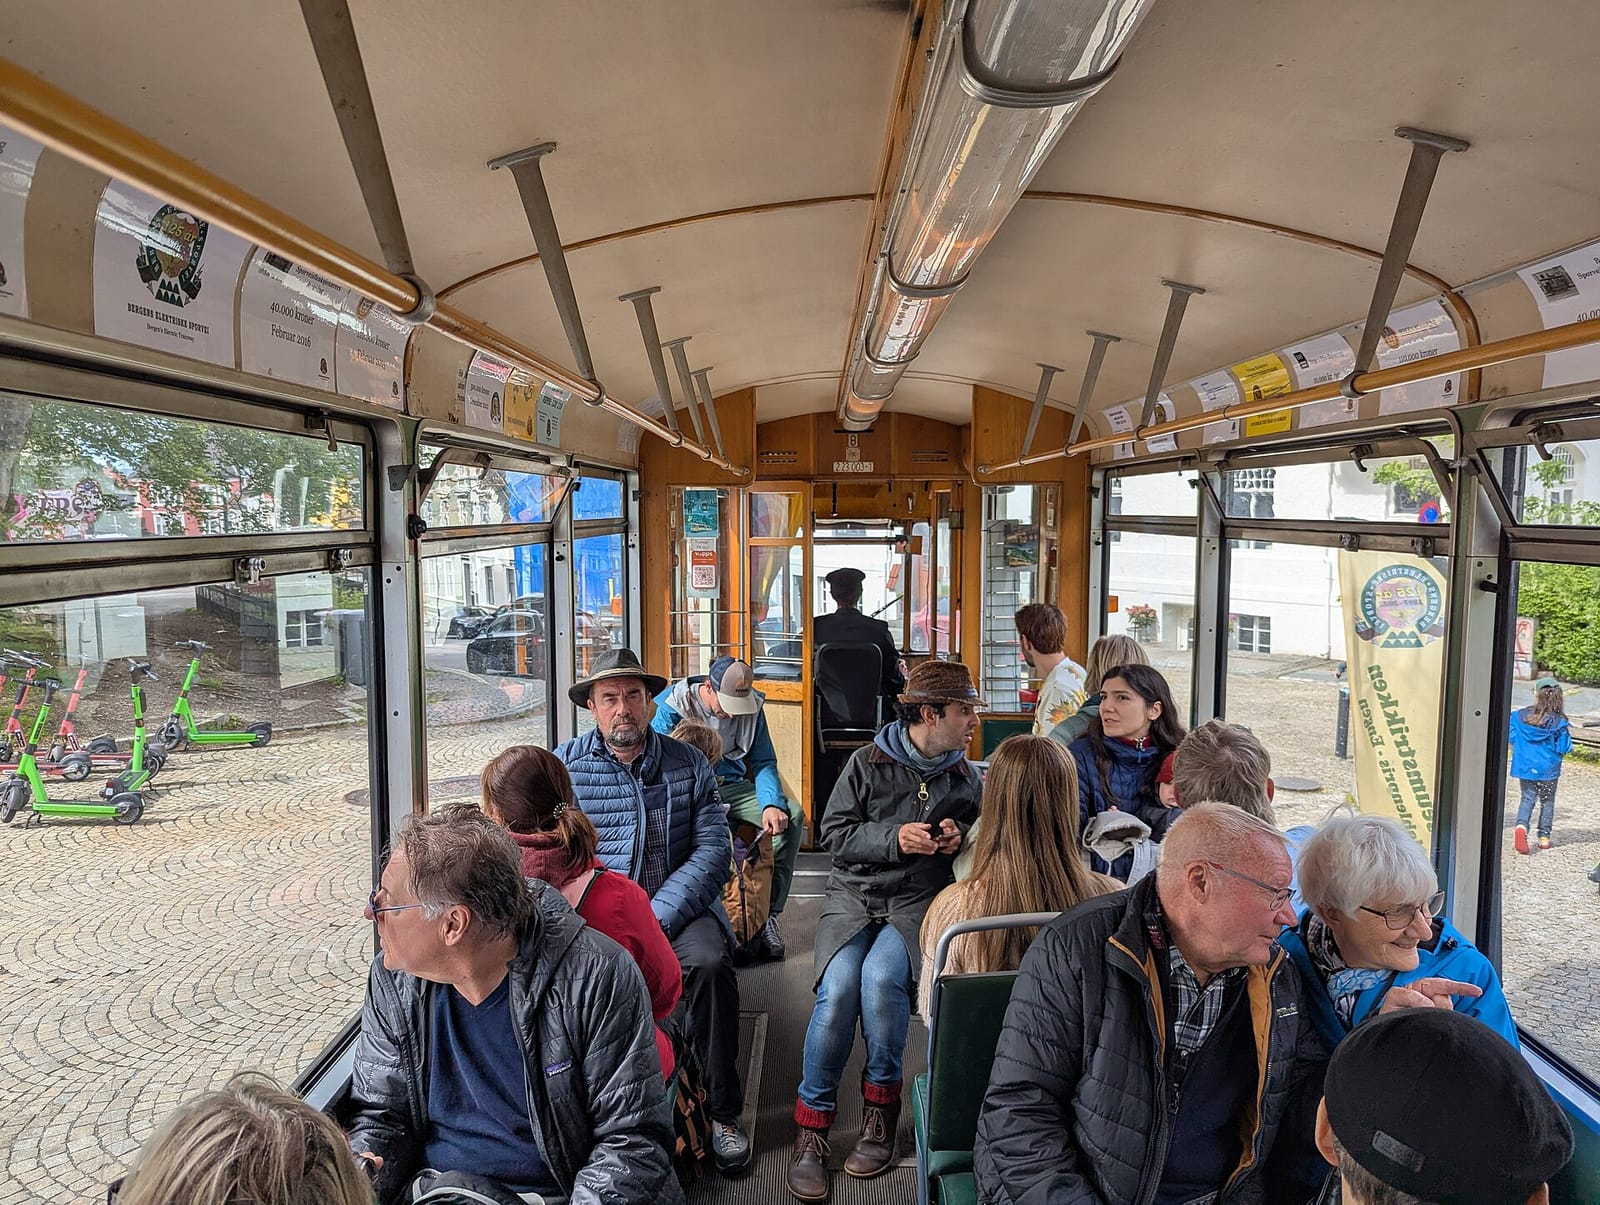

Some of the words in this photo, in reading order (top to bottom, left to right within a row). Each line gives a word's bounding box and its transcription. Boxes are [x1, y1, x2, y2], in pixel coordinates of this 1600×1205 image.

[163, 220, 184, 238] 125
[127, 302, 154, 319] BERGENS
[155, 311, 188, 329] ELEKTRISKE
[188, 320, 210, 335] SPORVEI
[270, 302, 294, 318] 40.000
[294, 307, 315, 326] kroner
[271, 323, 296, 343] Februar
[1419, 347, 1439, 360] kroner
